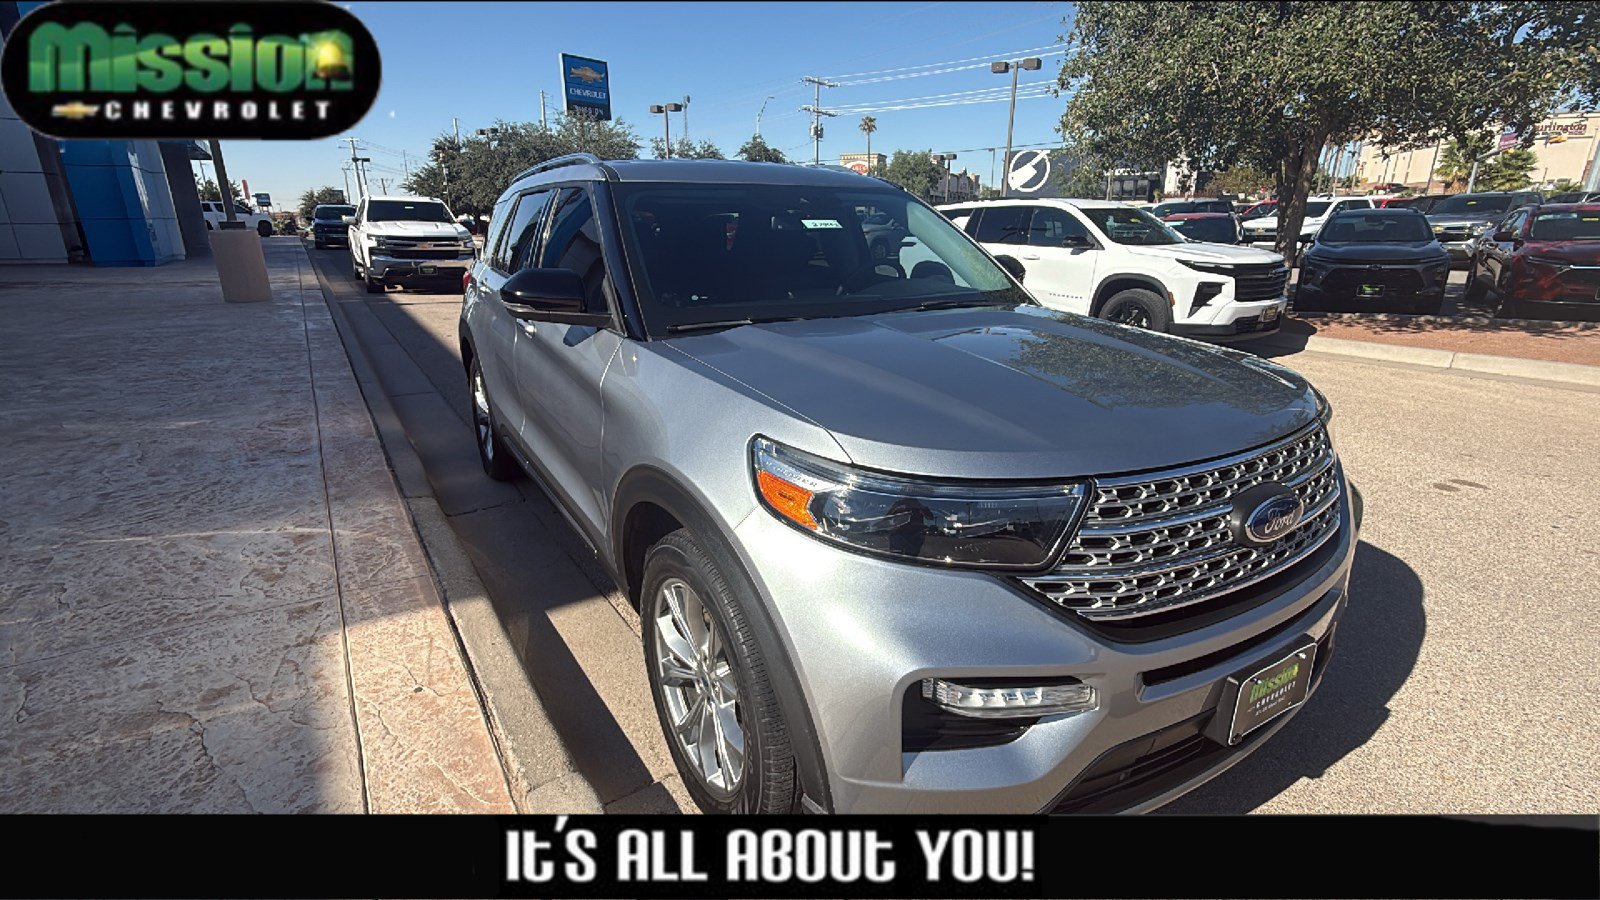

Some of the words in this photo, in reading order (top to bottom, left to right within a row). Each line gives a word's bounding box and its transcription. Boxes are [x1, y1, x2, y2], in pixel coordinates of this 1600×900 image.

[570, 88, 606, 99] CHEVROLET
[1533, 122, 1587, 133] urlington
[1264, 507, 1296, 534] Ford
